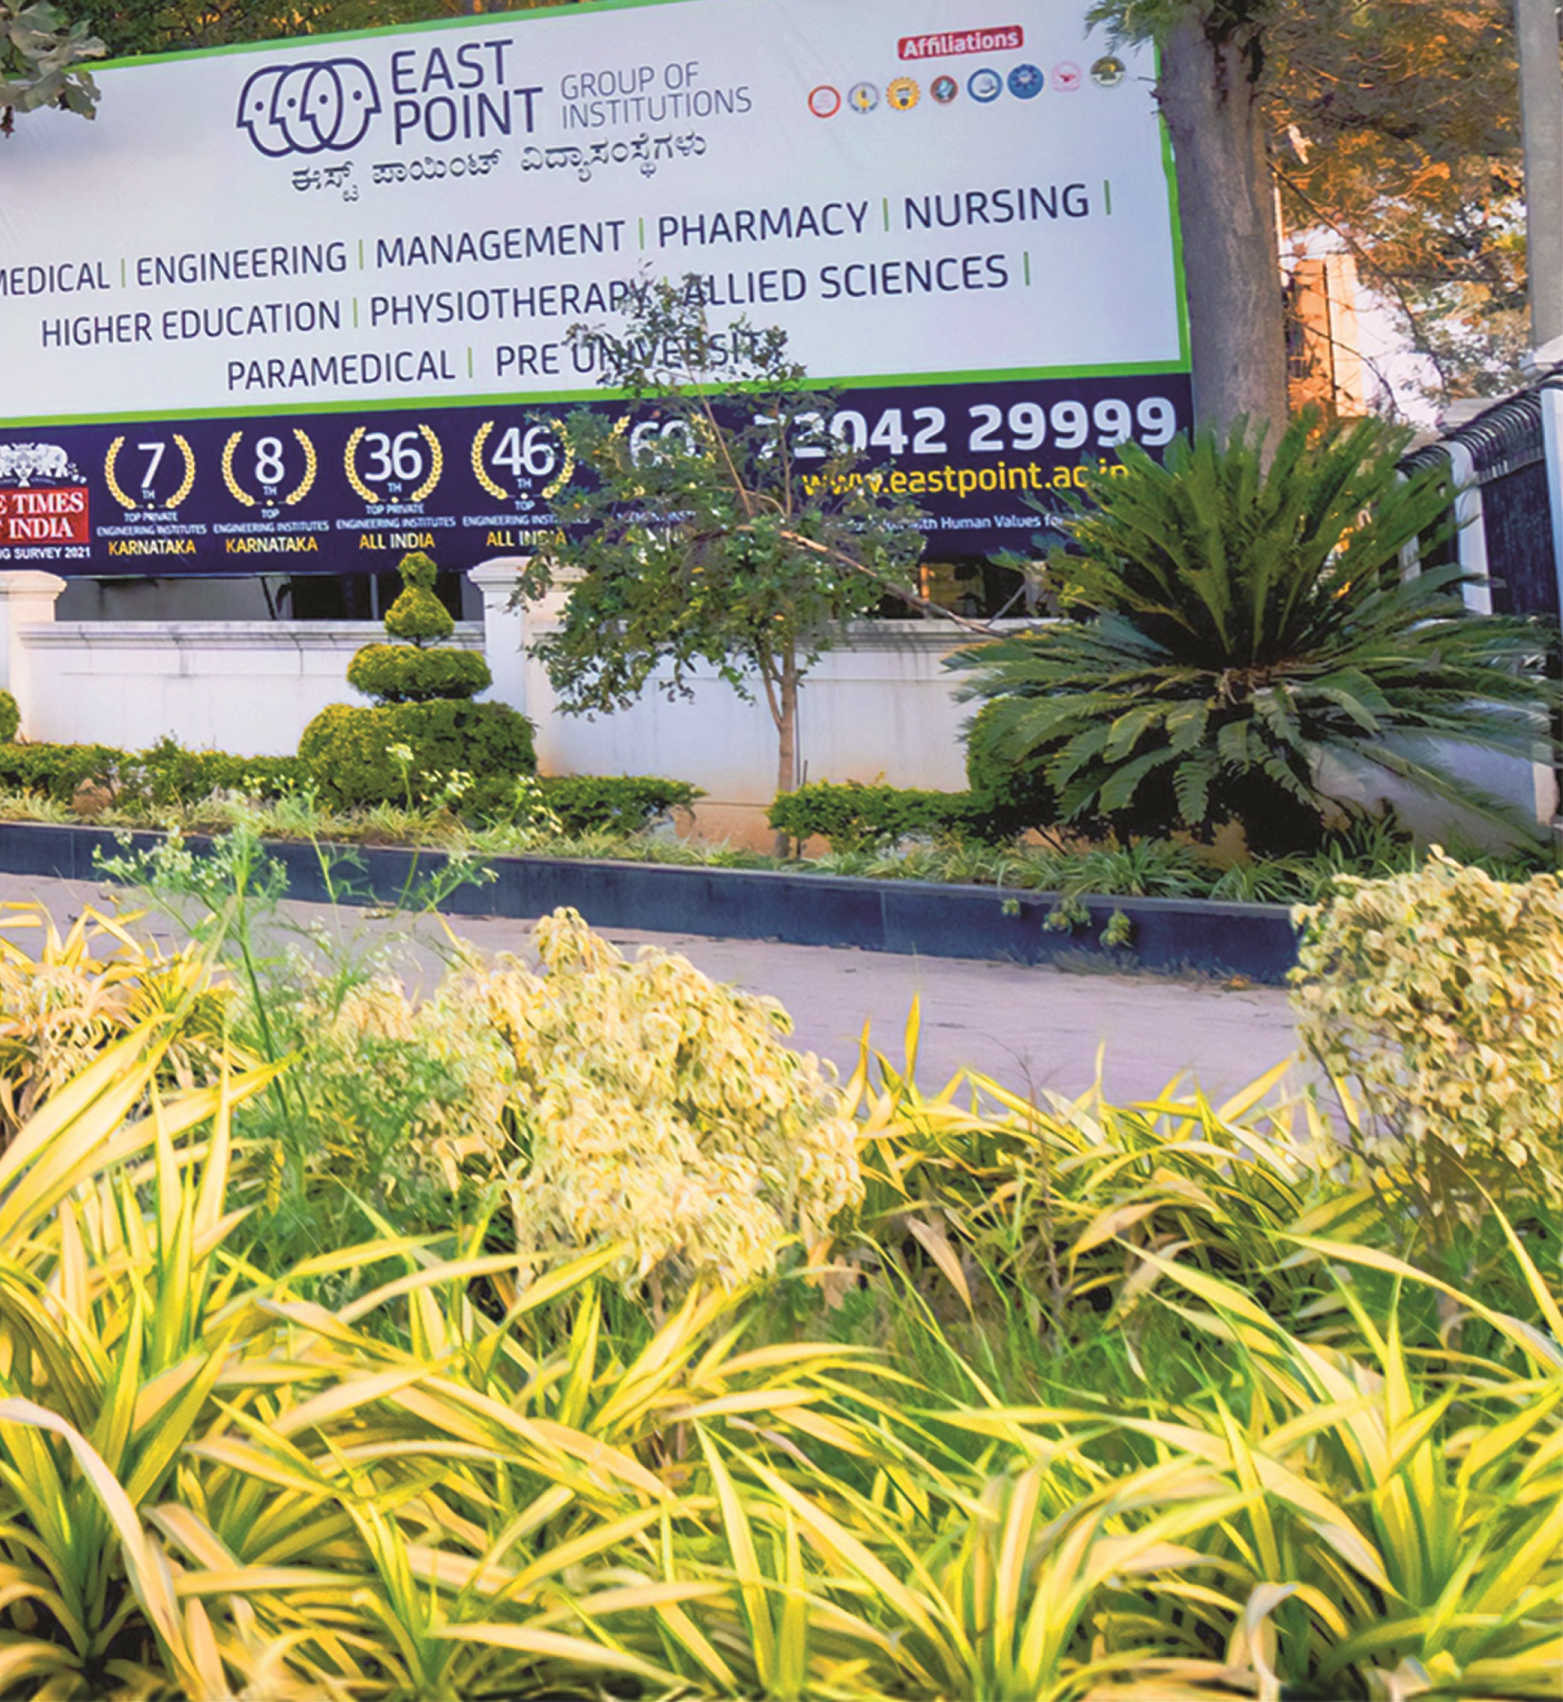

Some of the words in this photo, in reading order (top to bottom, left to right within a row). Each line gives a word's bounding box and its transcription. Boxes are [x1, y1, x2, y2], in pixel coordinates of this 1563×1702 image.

[903, 31, 1019, 58] Affiliations
[391, 39, 514, 95] EAST
[560, 66, 655, 103] GROUP
[664, 61, 699, 91] OF
[561, 83, 752, 129] INSTITUTIONS
[392, 84, 544, 146] POINT
[137, 241, 347, 286] ENGINEERING
[377, 220, 626, 269] MANAGEMENT
[658, 200, 868, 248] PHARMACY
[905, 183, 1089, 230] NURSING
[42, 312, 153, 348] HIGHER
[162, 300, 340, 340] EDUCATION
[685, 268, 808, 307] ALLIED
[820, 254, 1009, 299] SCIENCES
[228, 350, 456, 391] PARAMEDICAL
[496, 343, 560, 377] PRE
[969, 397, 1175, 452] 29999
[364, 431, 423, 481] 36
[491, 426, 555, 476] 46
[138, 443, 165, 488] 7
[255, 437, 285, 484] 8
[262, 486, 277, 496] TH
[387, 482, 402, 494] TH
[516, 478, 532, 489] TH
[12, 492, 85, 515] TIMES
[142, 489, 155, 501] TH
[261, 508, 280, 519] TOP
[365, 504, 384, 515] TOP
[386, 503, 424, 514] PRIVATE
[514, 501, 535, 511] TOP
[124, 512, 141, 523] TOP
[142, 511, 178, 522] PRIVATE
[336, 518, 400, 530] ENGINEERING
[402, 516, 456, 528] INSTITUTES
[462, 515, 529, 527] ENGINEERING
[941, 517, 992, 528] Human
[994, 515, 1041, 528] Values
[9, 517, 74, 538] INDIA
[96, 526, 155, 537] ENGINEERING
[158, 524, 206, 535] INSTITUTES
[213, 522, 274, 534] ENGINEERING
[277, 520, 330, 532] INSTITUTES
[225, 536, 318, 553] KARNATAKA
[359, 534, 386, 549] ALL
[390, 533, 436, 549] INDIA
[486, 531, 514, 546] ALL
[14, 547, 62, 559] SURVEY
[64, 546, 90, 558] 2021
[108, 539, 196, 556] KARNATAKA
